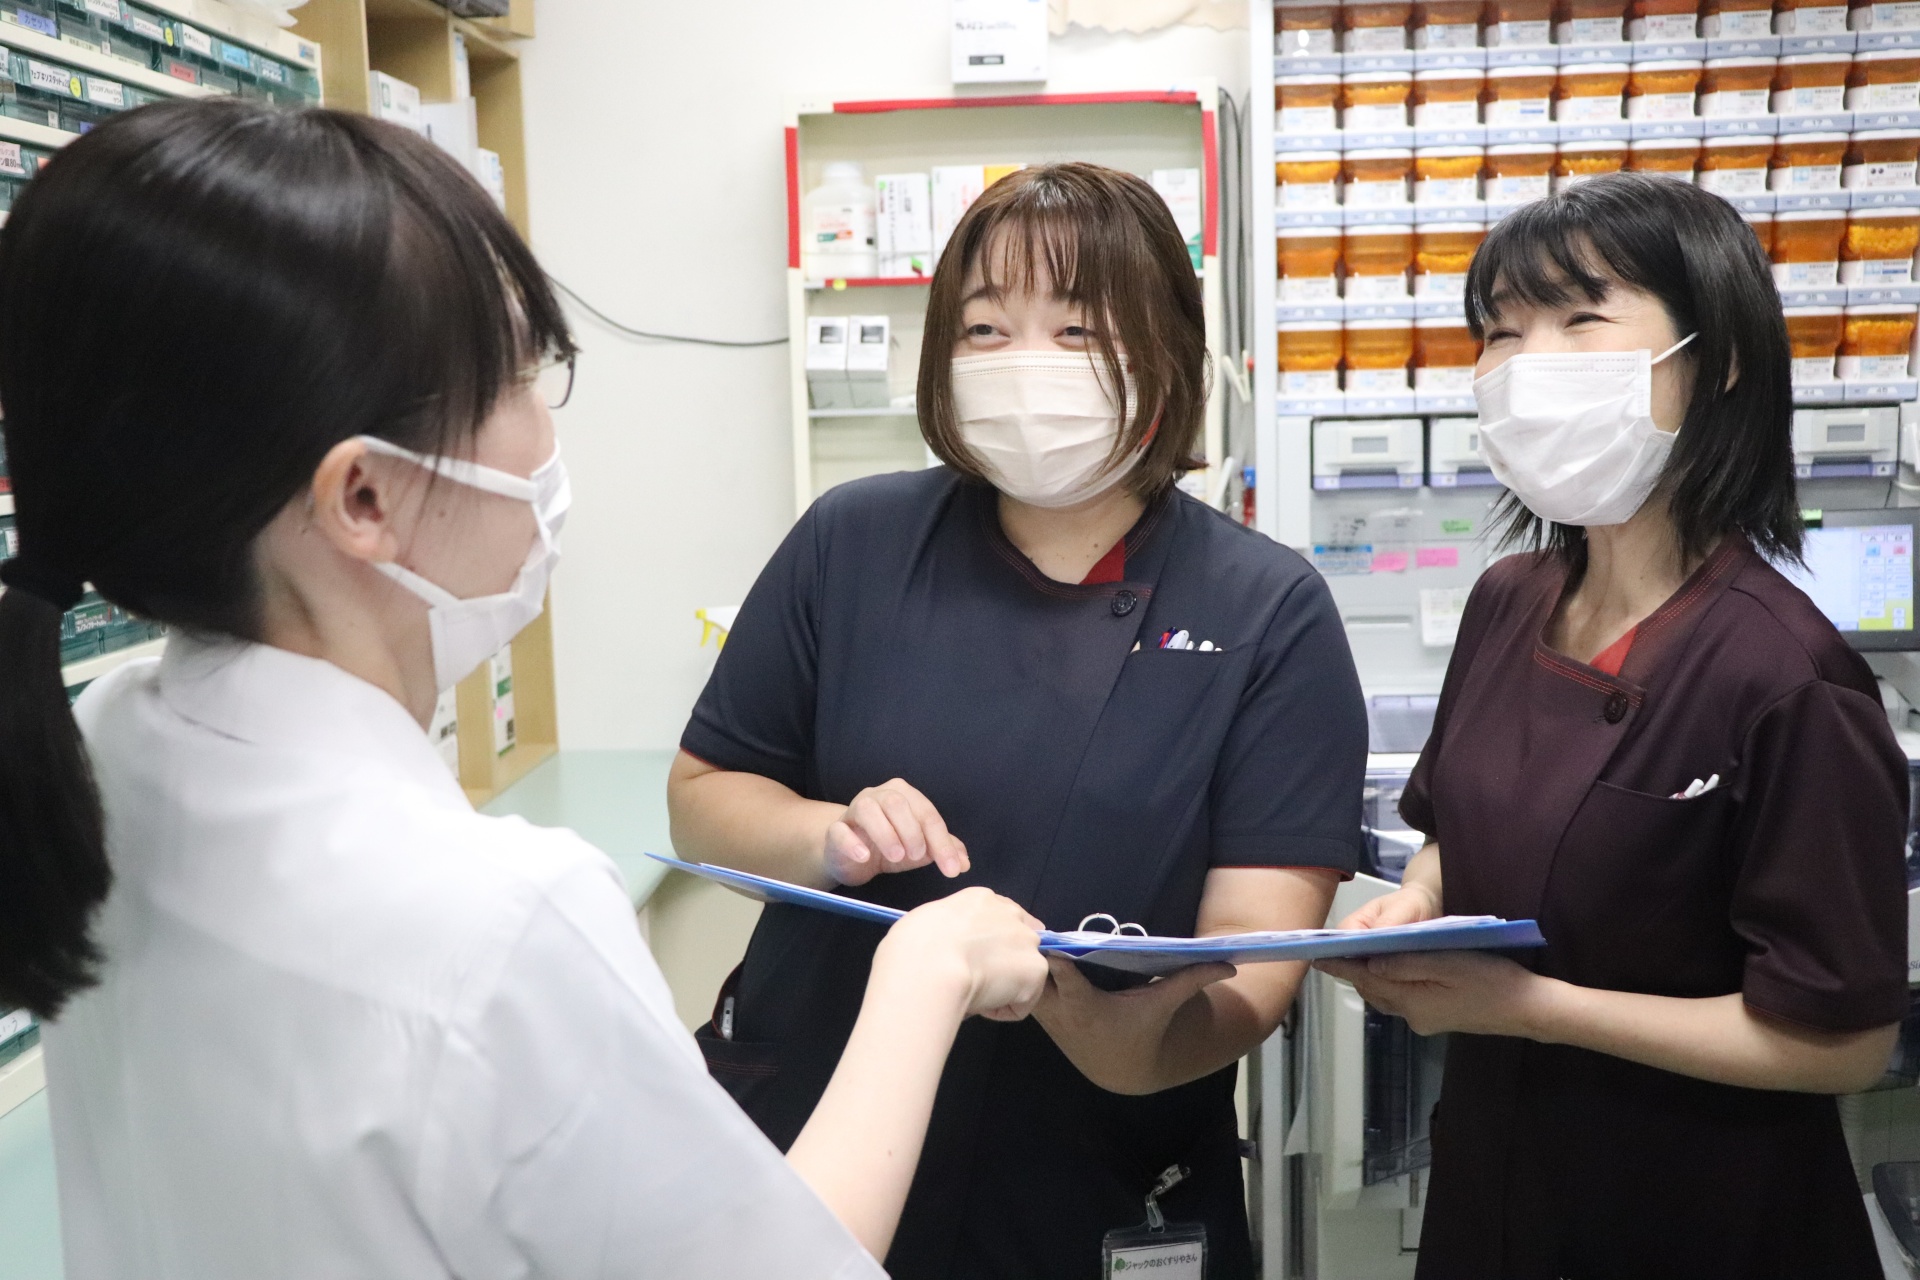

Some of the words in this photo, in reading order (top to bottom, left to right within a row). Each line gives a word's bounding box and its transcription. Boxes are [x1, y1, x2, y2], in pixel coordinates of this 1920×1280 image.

[1125, 1253, 1198, 1271] ジャックのおくすりやさん
